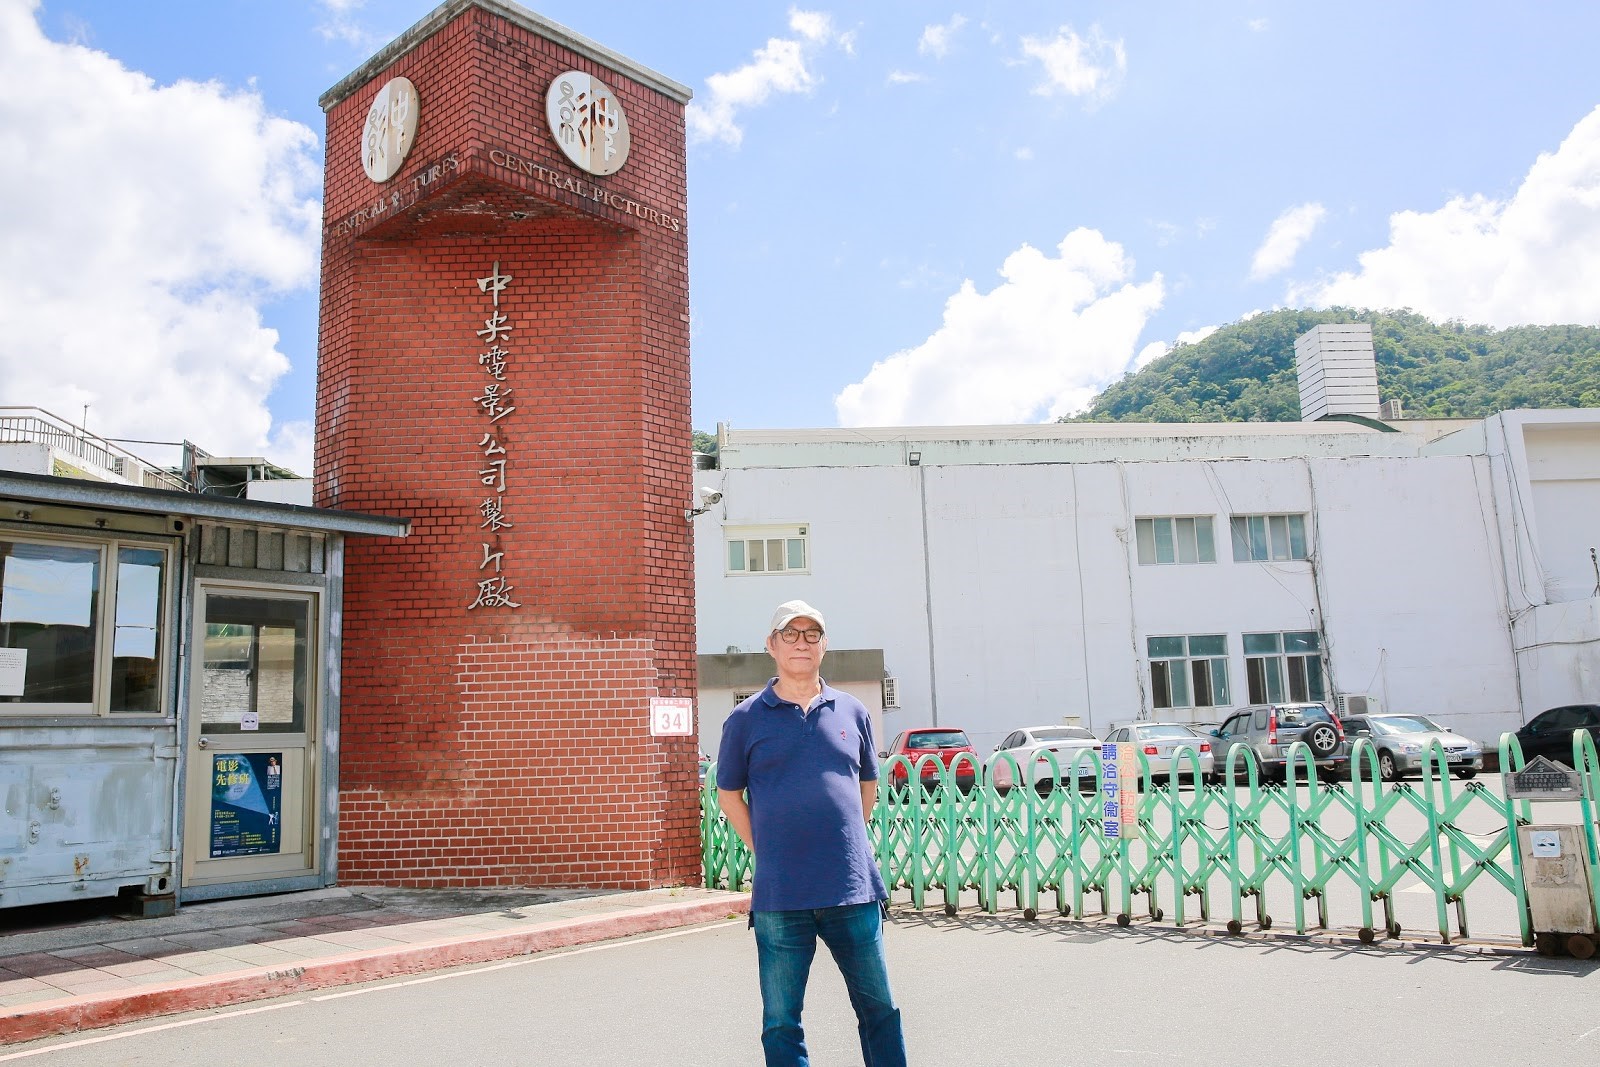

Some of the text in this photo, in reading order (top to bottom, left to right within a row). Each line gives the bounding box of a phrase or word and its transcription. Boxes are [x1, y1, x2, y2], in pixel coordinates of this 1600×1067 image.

[488, 149, 680, 233] CENTRAL PICTURES
[332, 198, 388, 237] ENTRAL
[468, 260, 521, 610] 中央電影公司製片廠
[661, 713, 682, 730] 34
[216, 760, 239, 772] 電影
[216, 773, 250, 786] 先修班
